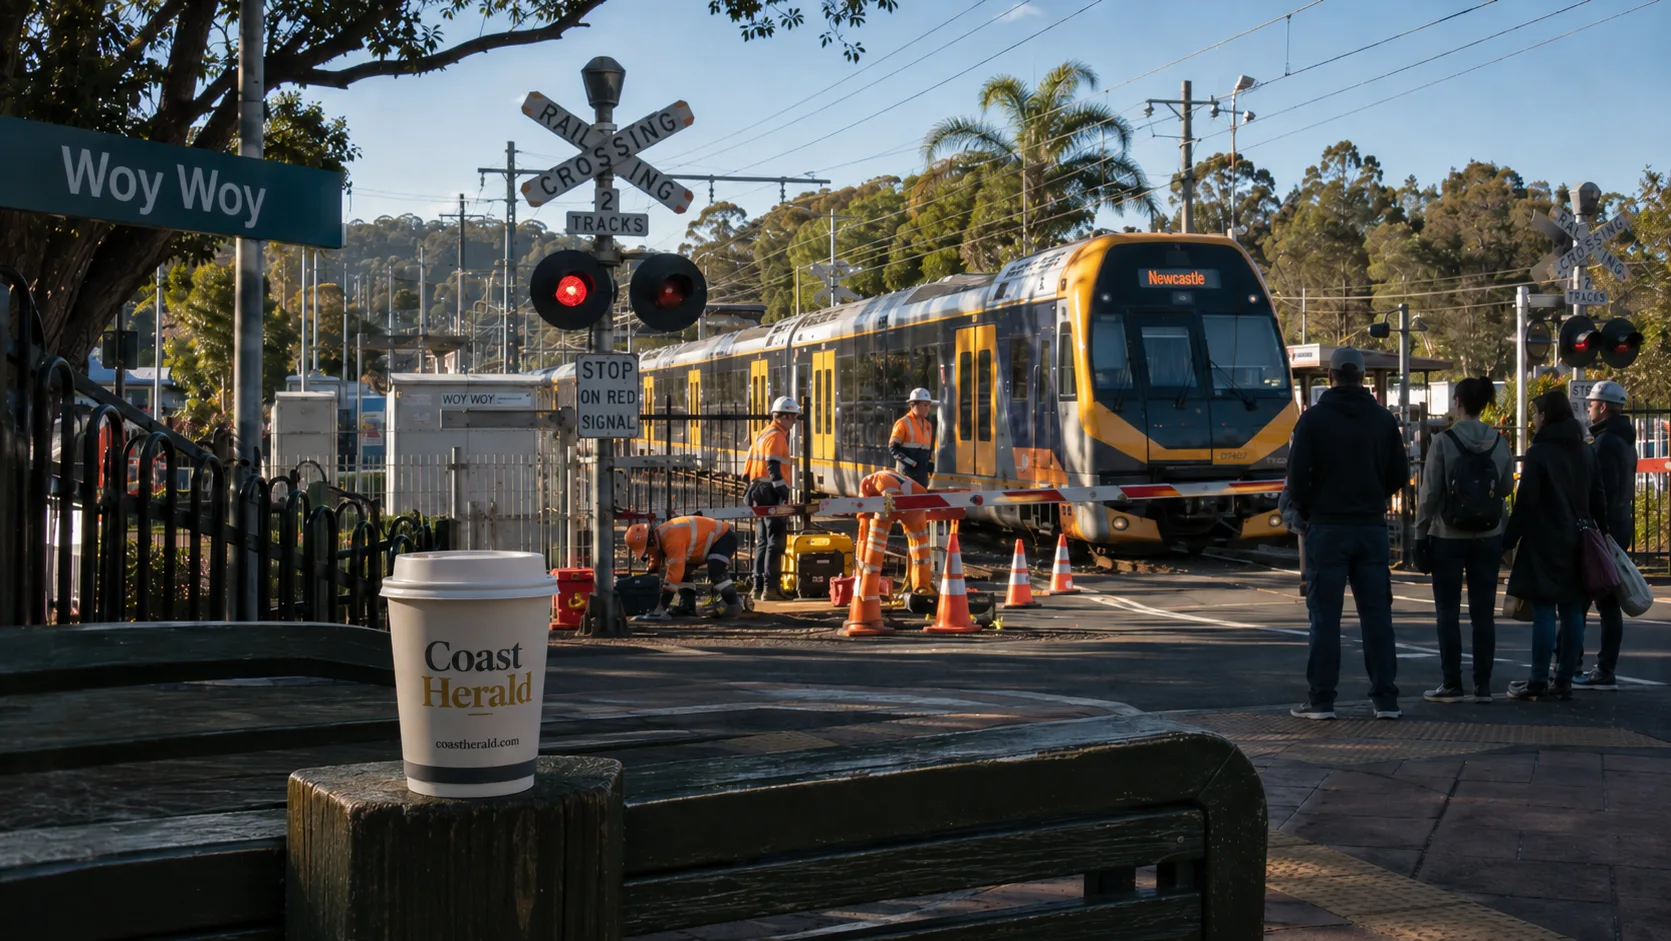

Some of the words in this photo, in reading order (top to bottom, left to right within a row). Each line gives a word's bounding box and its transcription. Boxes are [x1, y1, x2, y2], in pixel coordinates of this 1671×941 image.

[539, 103, 589, 150] RAIL
[540, 112, 677, 196] CROSSING
[61, 145, 164, 215] Woy
[176, 163, 267, 229] Woy
[600, 191, 613, 211] 2
[572, 215, 644, 233] TRACKS
[1560, 216, 1623, 270] CROSSING
[1148, 269, 1205, 285] Newcastle
[1584, 277, 1592, 290] 2
[582, 361, 633, 380] STOP
[442, 393, 468, 405] WOY
[470, 393, 495, 405] WOY
[580, 389, 600, 404] ON
[607, 390, 636, 404] RED
[582, 414, 636, 430] SIGNAL
[424, 640, 523, 672] Coast
[421, 671, 532, 709] Herald
[435, 737, 520, 749] coastherald.com
